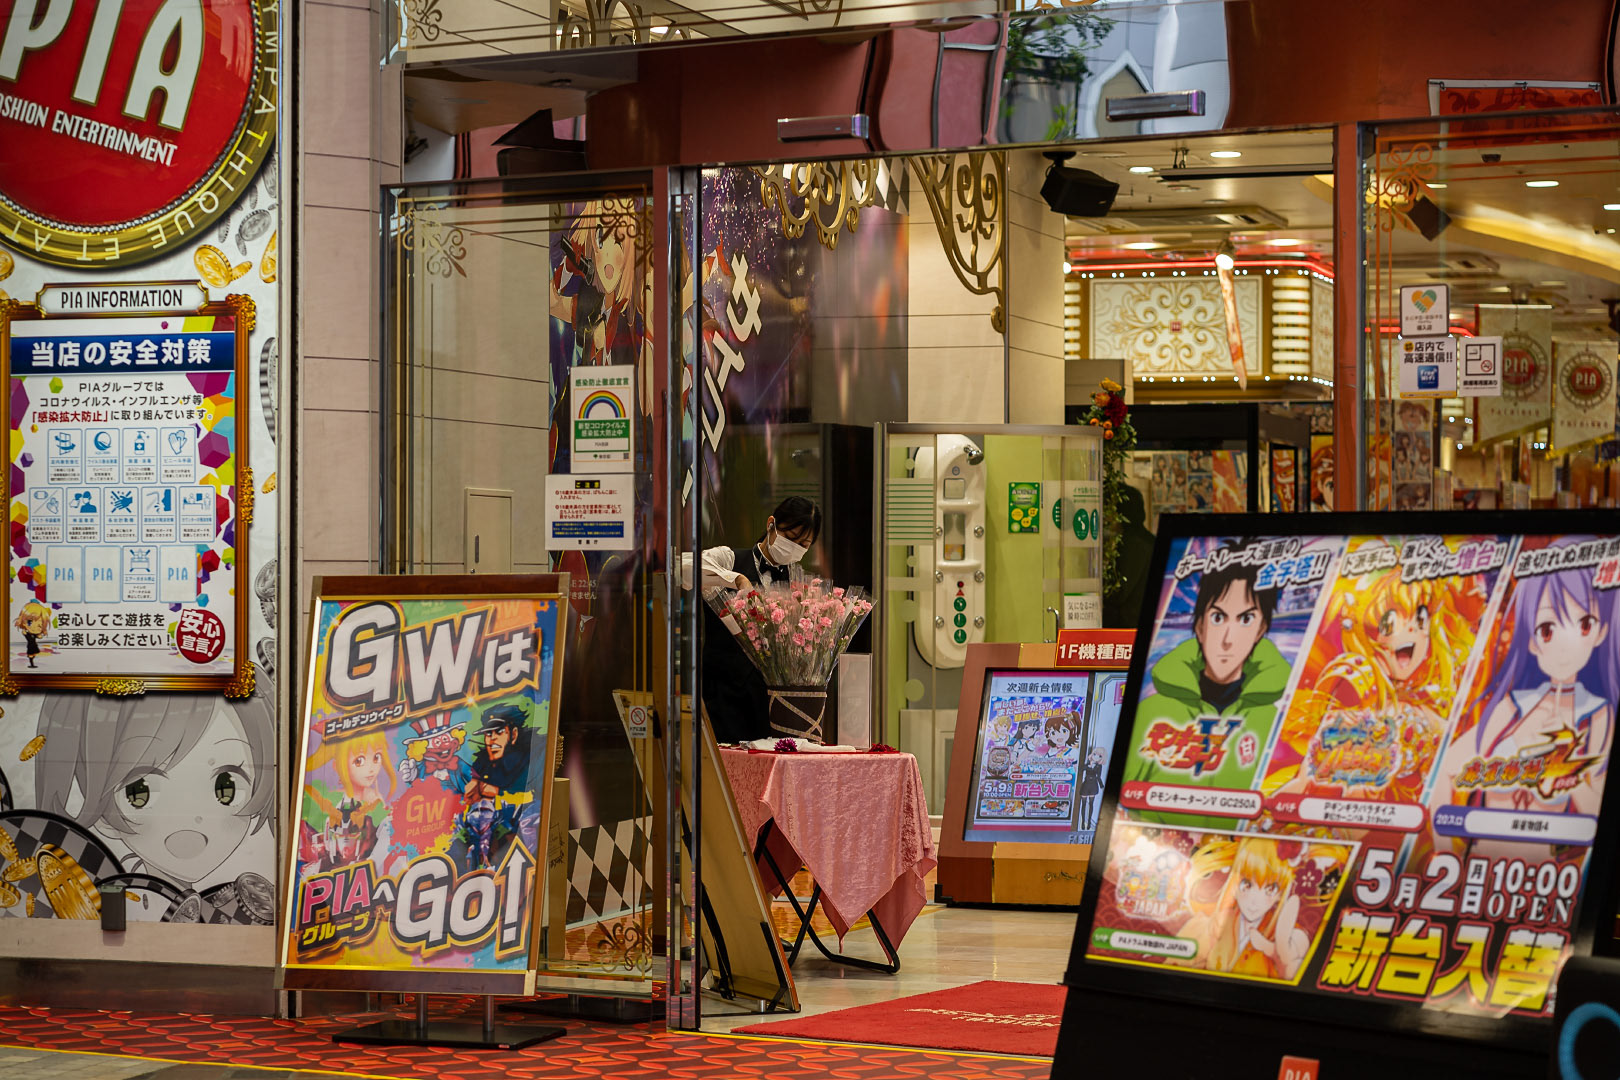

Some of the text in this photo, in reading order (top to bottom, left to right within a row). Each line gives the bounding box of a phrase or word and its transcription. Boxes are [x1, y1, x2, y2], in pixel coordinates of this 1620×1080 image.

[0, 0, 206, 132] PIA
[51, 110, 178, 167] ENTERTAINMENT
[61, 289, 183, 309] PIA INFORMATION
[31, 338, 212, 368] 当店の安全対策
[1415, 341, 1445, 352] 店内で
[1504, 357, 1529, 373] PIA
[79, 381, 164, 393] PIAグループでは
[1575, 372, 1597, 387] PIA
[39, 395, 203, 408] コロナウイルス・インフルエンザ等
[31, 409, 213, 424] 「感染拡大防止」に取り組んでいます。
[54, 567, 74, 581] PIA
[93, 567, 113, 581] PIA
[168, 567, 188, 581] PIA
[1597, 558, 1620, 585] 増
[58, 613, 165, 628] 安心してご遊技を
[181, 609, 220, 640] 安心
[329, 604, 532, 705] GWは
[1007, 682, 1073, 693] 次週新台情報
[1014, 783, 1070, 797] 新台入替
[405, 795, 446, 823] GW
[406, 820, 446, 838] PIA GROUP
[1491, 860, 1579, 900] 10:00
[302, 868, 370, 923] PIA
[1487, 893, 1573, 923] OPEN
[303, 912, 370, 946] グループ
[1320, 912, 1565, 1012] 新台入替
